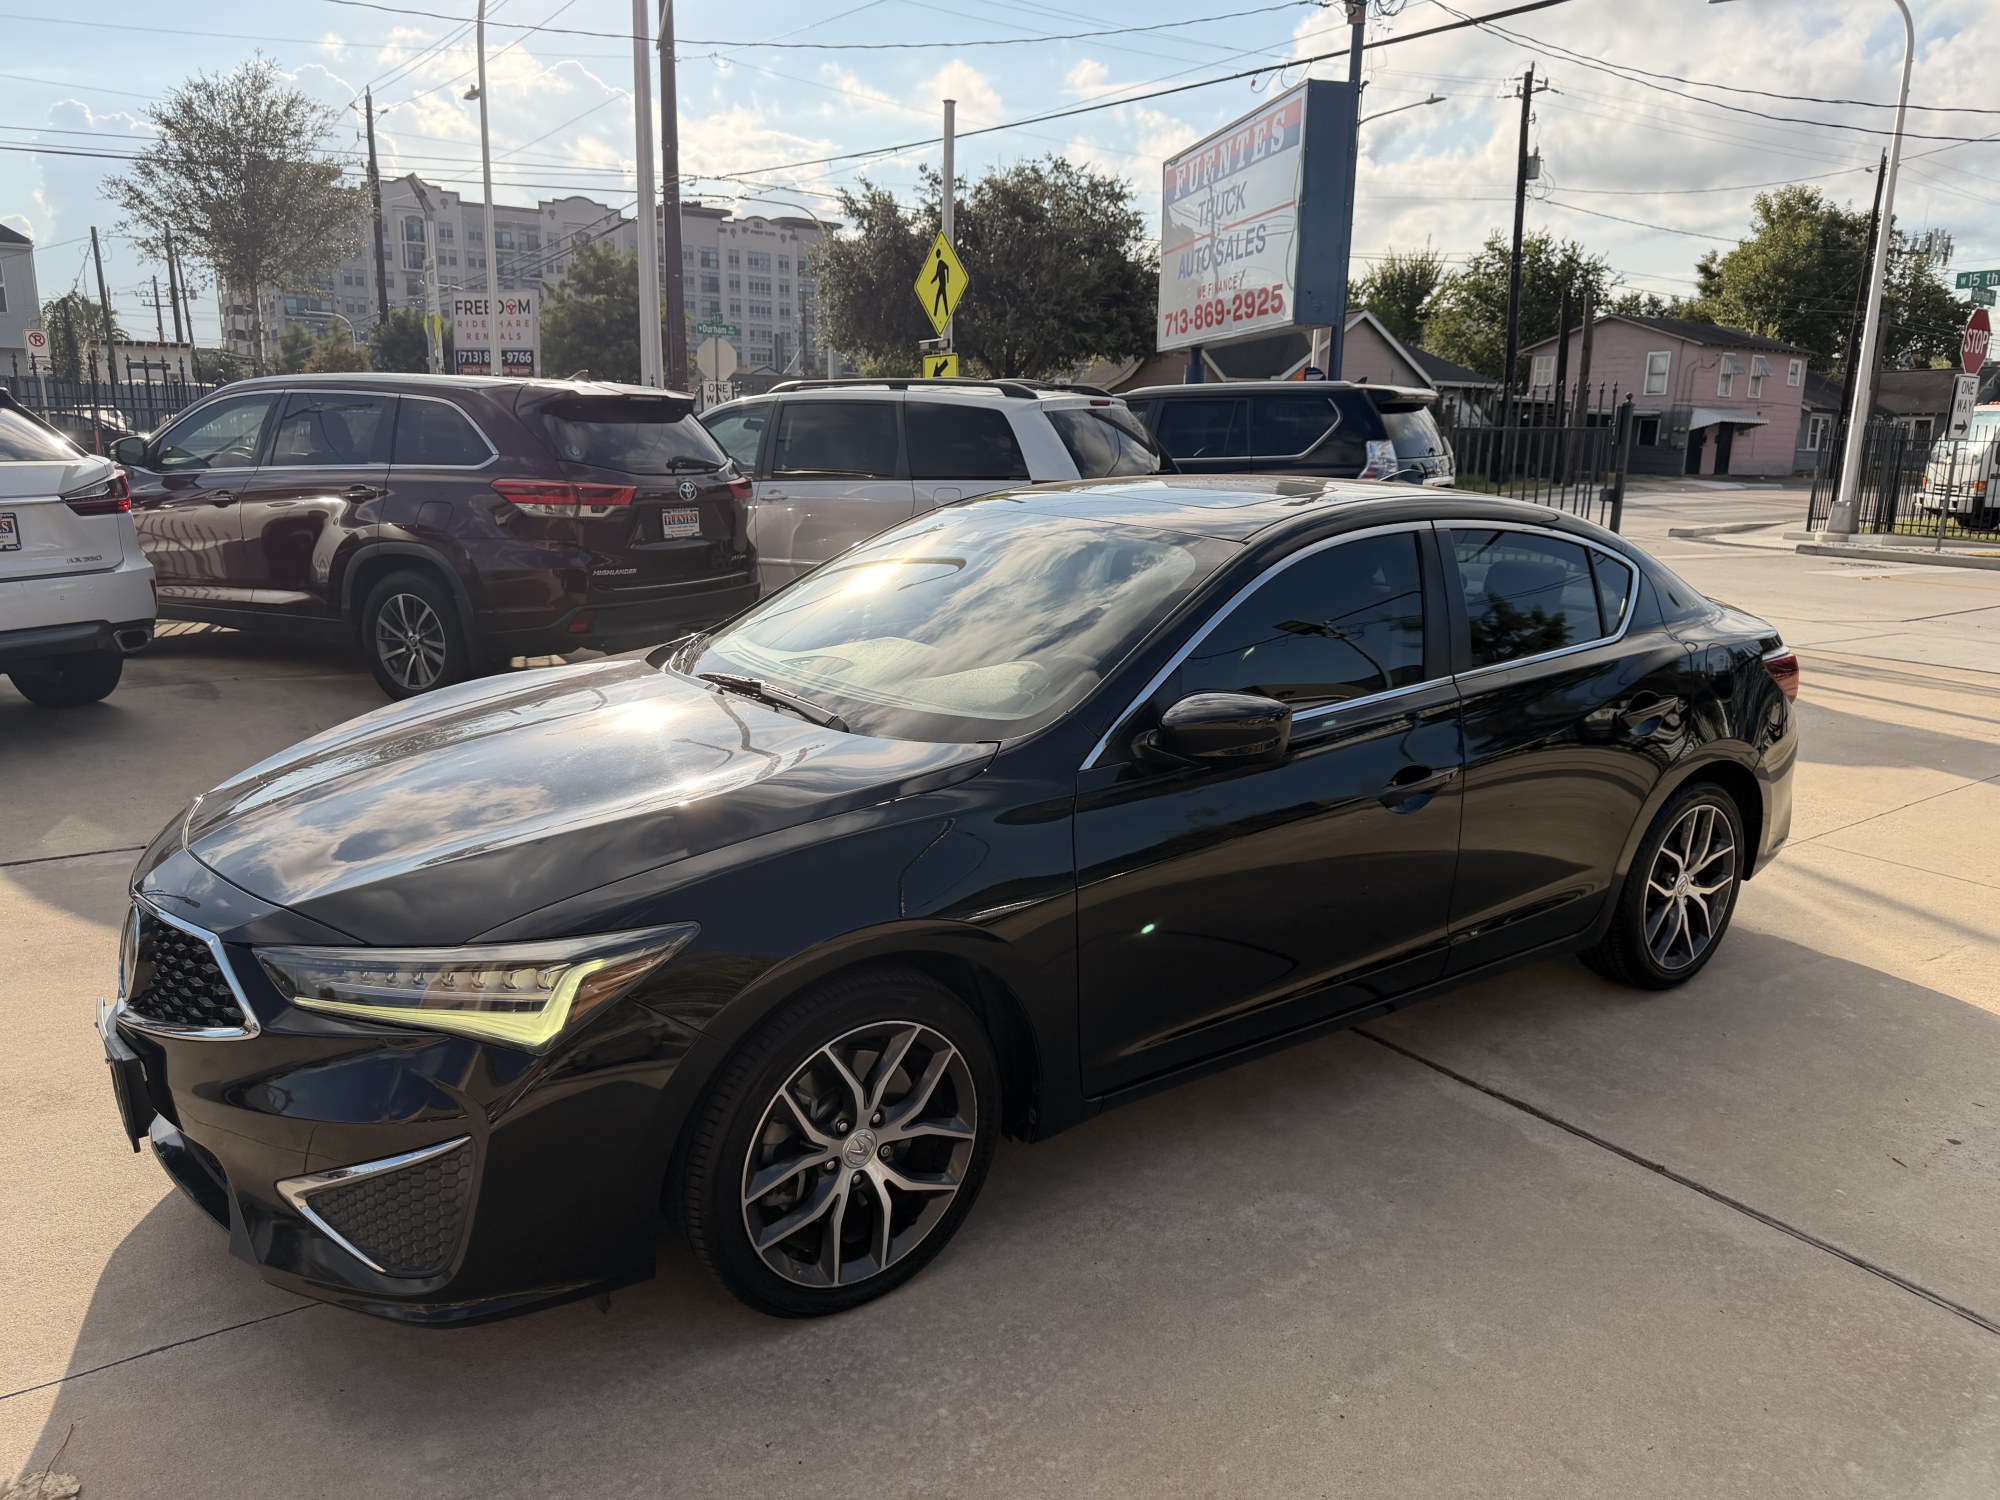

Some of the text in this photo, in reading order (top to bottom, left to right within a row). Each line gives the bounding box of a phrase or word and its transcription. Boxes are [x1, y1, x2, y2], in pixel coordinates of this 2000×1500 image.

[1174, 109, 1286, 199] FUENTES
[1198, 181, 1247, 227] TRUCK
[1178, 223, 1267, 280] AUTO SALES
[1969, 273, 1980, 287] 15
[1986, 272, 1998, 285] th
[1165, 283, 1284, 337] 713-869-2925
[466, 333, 522, 341] RENALS
[1964, 330, 1989, 354] STOP
[483, 351, 532, 364] 8-9766
[1961, 380, 1976, 395] ONE
[1956, 399, 1974, 413] WAY
[664, 513, 697, 526] FUENTES
[593, 568, 638, 576] HIGHLANDER
